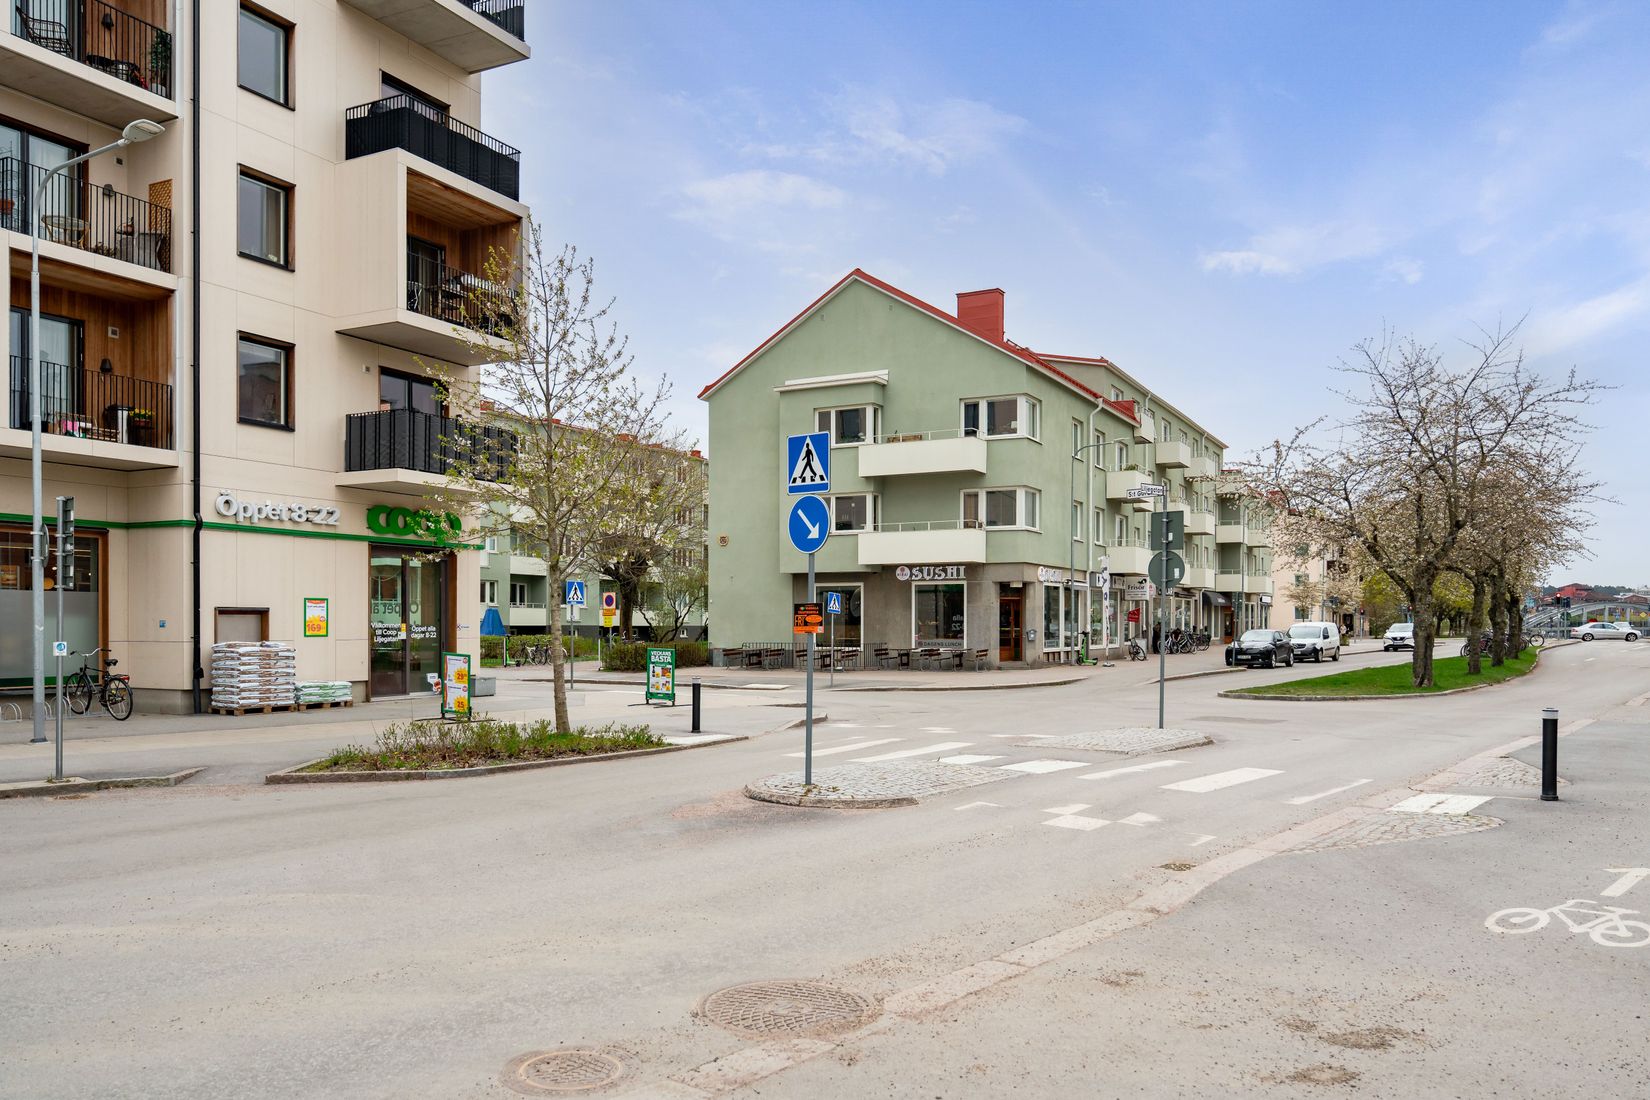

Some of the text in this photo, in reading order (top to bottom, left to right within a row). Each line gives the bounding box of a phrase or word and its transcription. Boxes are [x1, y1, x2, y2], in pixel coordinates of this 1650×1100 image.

[215, 489, 341, 526] Öppet 8-22
[911, 565, 966, 580] SUSHI
[306, 623, 321, 633] 169
[382, 628, 397, 636] Coop
[411, 624, 427, 632] Öppet
[411, 631, 425, 639] dagar
